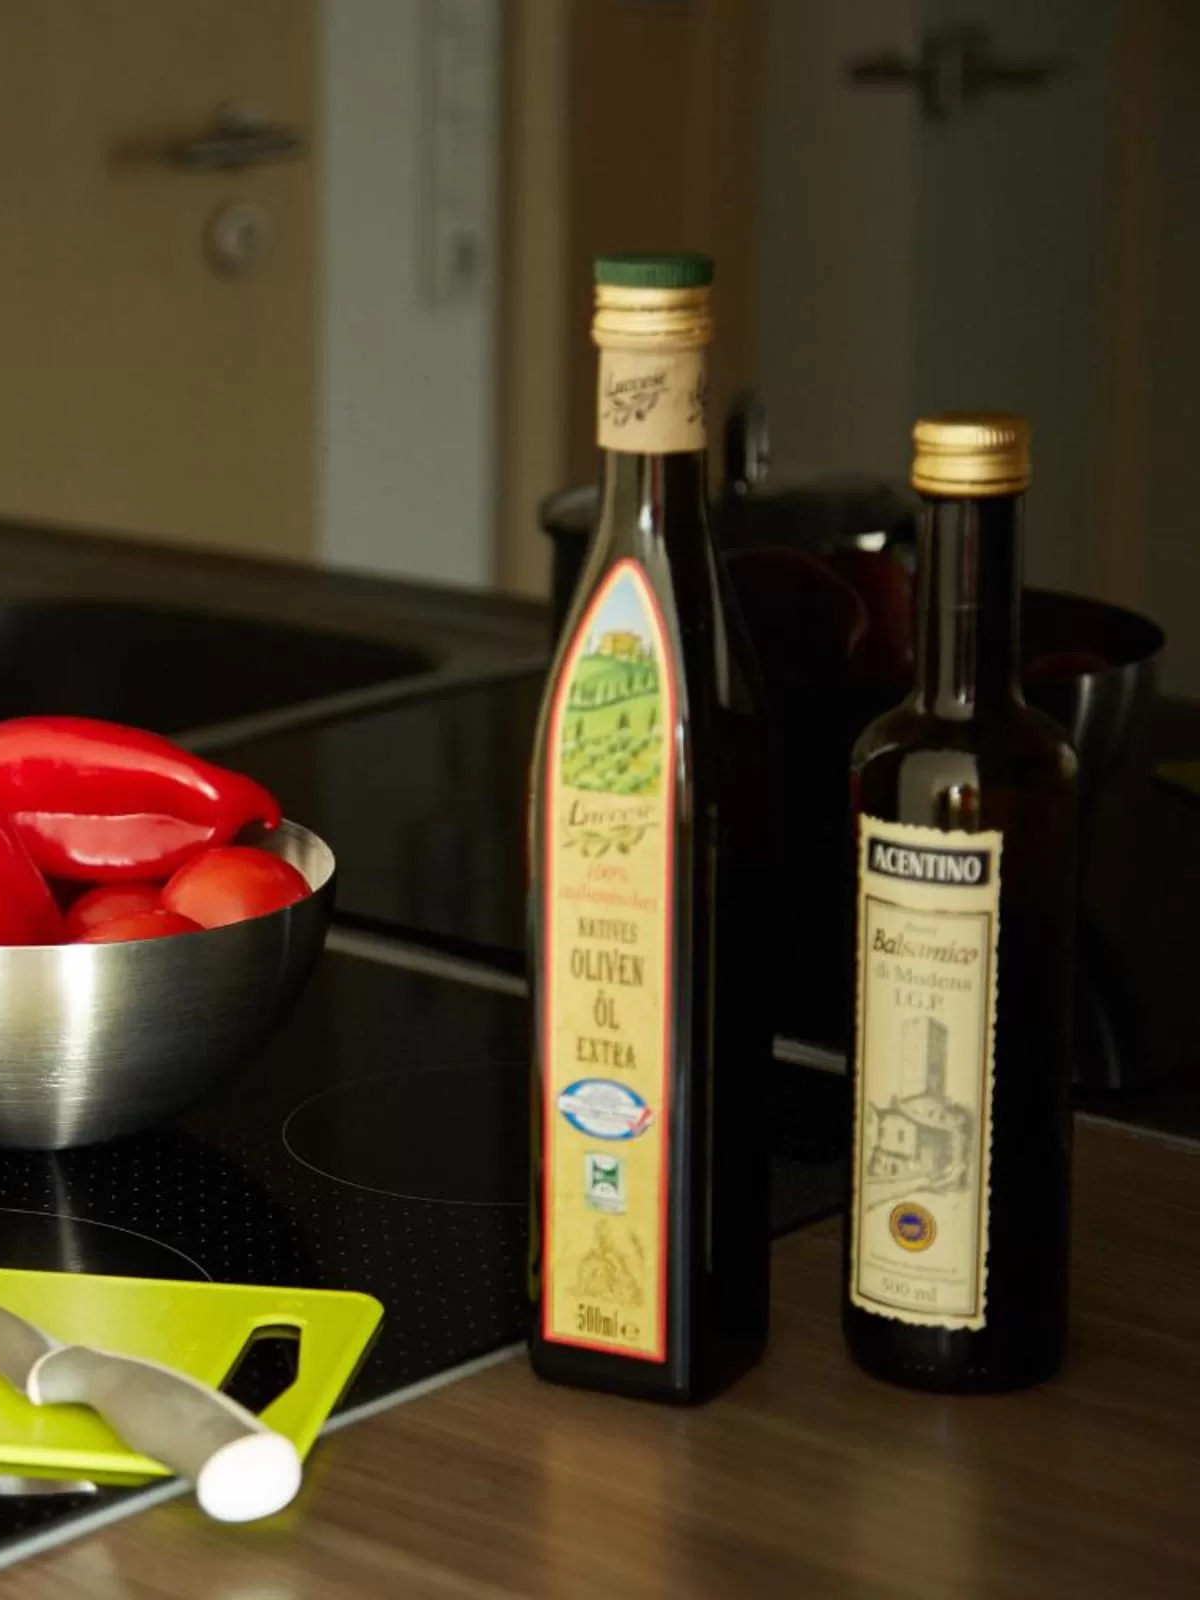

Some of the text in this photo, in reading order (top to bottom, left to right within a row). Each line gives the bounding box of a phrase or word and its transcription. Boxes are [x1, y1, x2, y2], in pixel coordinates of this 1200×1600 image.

[872, 843, 982, 883] ACENTINO
[577, 915, 639, 945] NATIVES
[873, 926, 978, 965] Balsamico
[569, 946, 645, 987] OLIVEN
[592, 987, 621, 1031] ÖL
[575, 1035, 637, 1070] EXTRA
